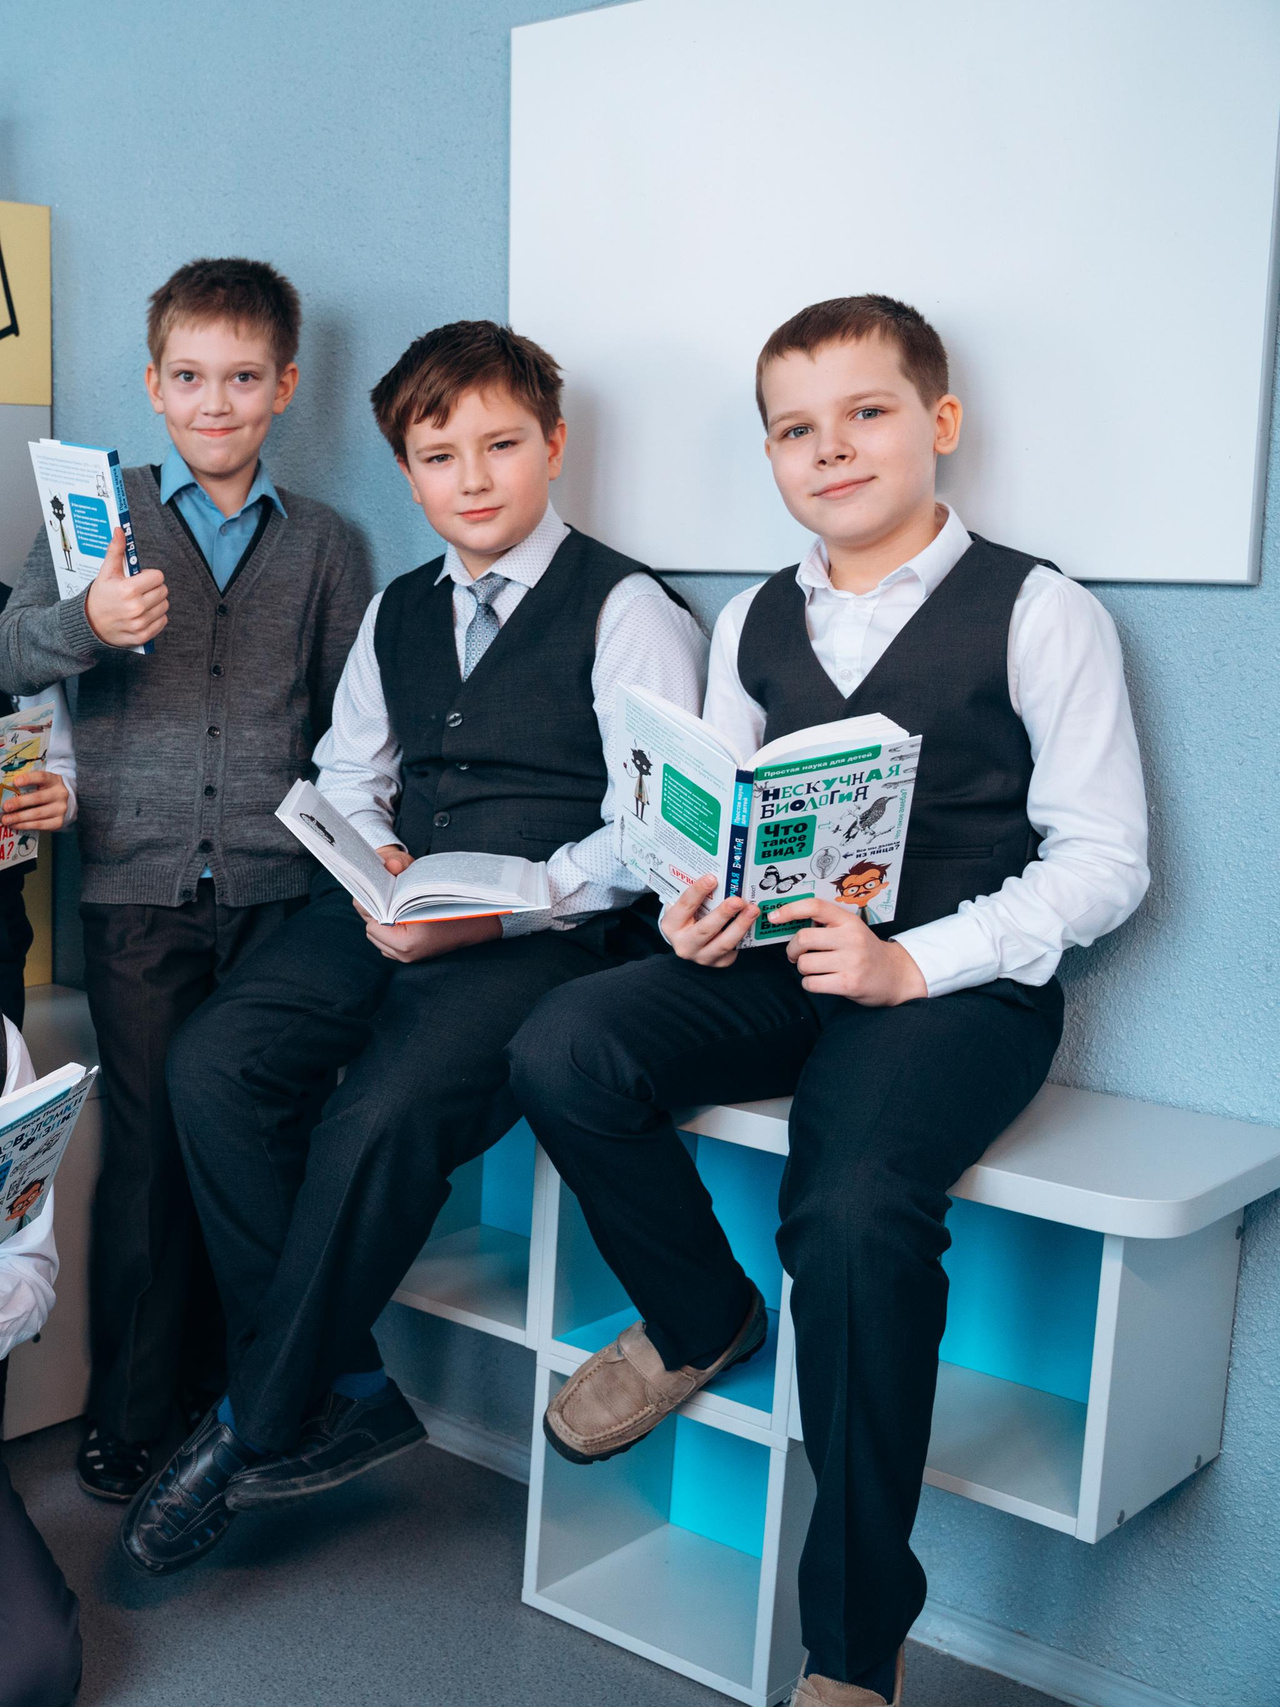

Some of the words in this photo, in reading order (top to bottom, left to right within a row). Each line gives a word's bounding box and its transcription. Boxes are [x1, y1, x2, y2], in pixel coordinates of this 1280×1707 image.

[764, 767, 800, 778] Простая
[802, 762, 827, 771] наука
[829, 757, 846, 766] для
[847, 752, 873, 763] детей
[761, 763, 901, 802] НЕСКУЧНАЯ
[760, 785, 869, 820] БИОЛОГИЯ
[762, 834, 807, 848] такое
[764, 822, 808, 837] Что
[761, 842, 806, 859] вид?
[19, 1107, 79, 1151] ФИЗИКЕ
